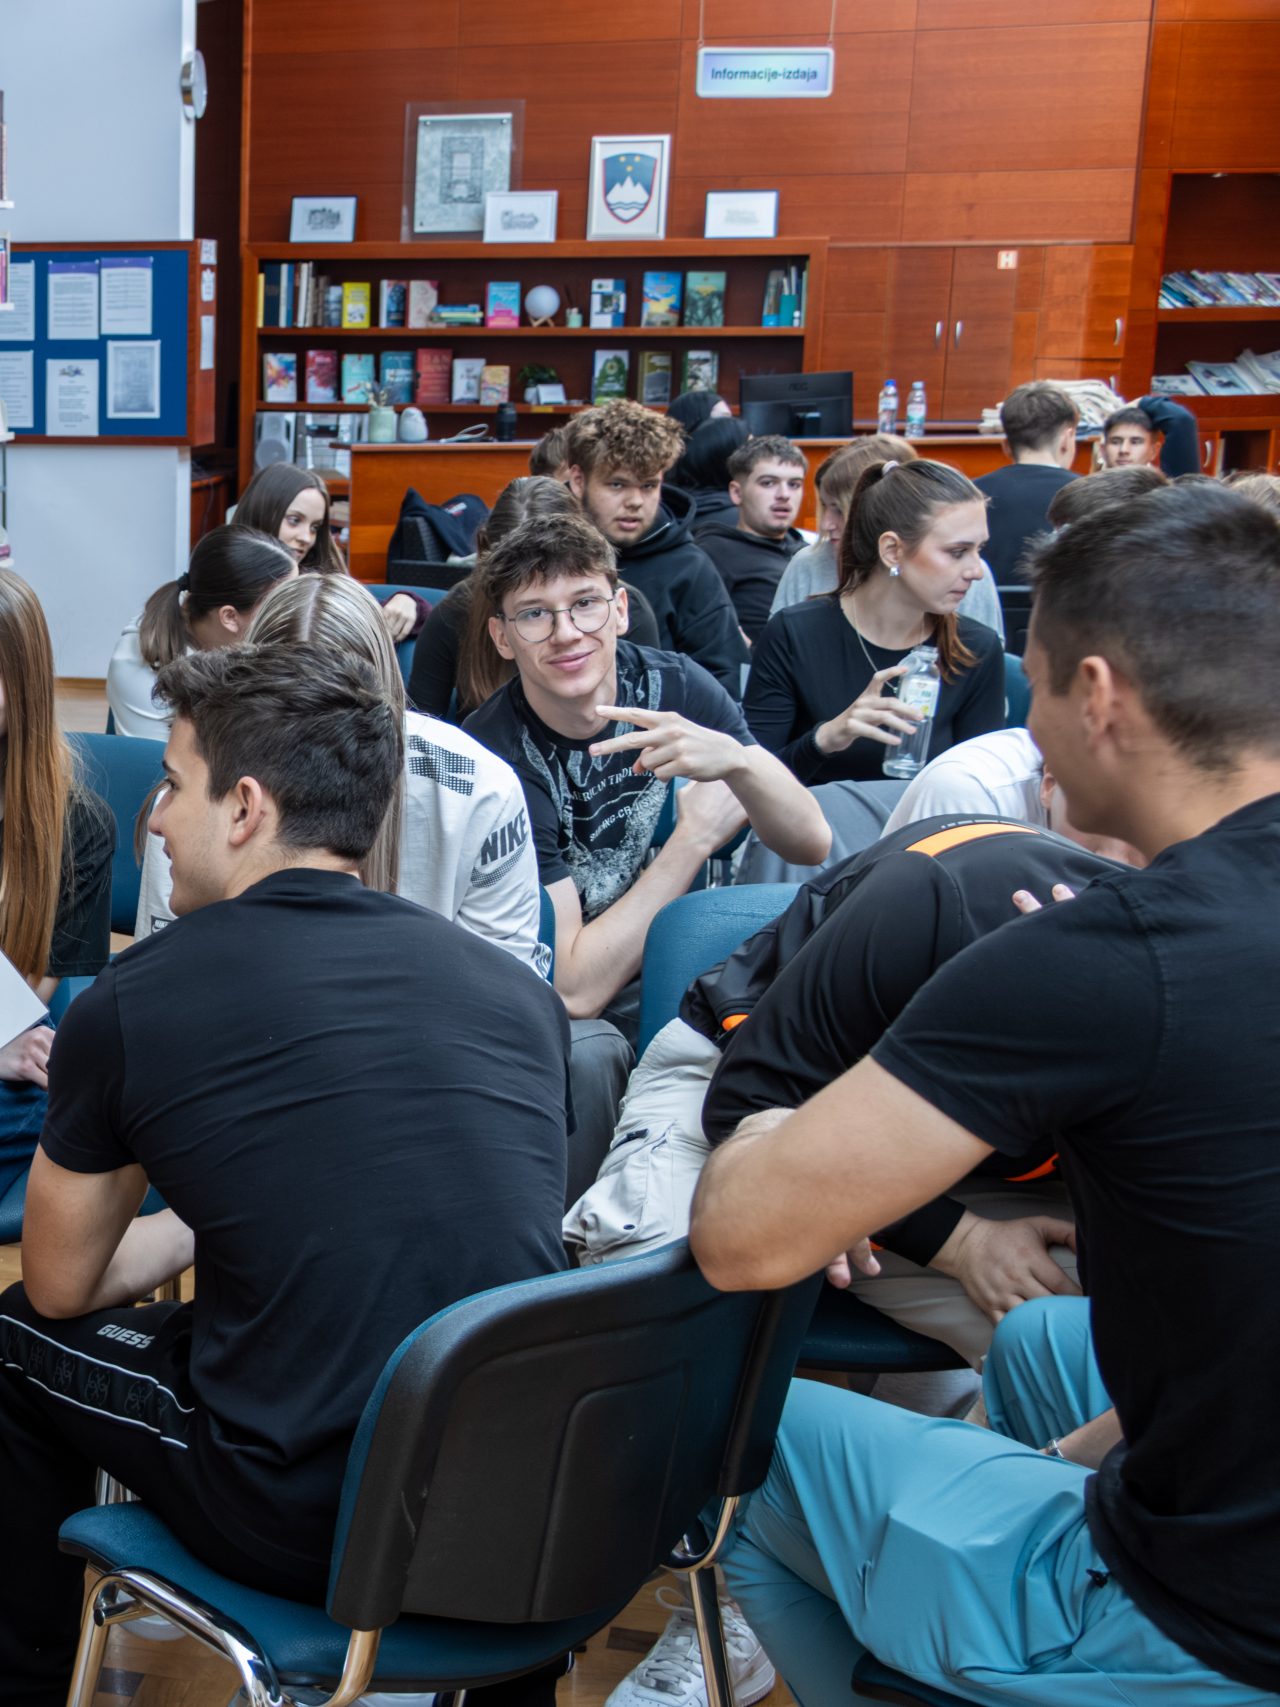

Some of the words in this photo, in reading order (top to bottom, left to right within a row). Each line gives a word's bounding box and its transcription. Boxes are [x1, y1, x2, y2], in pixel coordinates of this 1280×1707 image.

[711, 68, 818, 82] Informacije-izdaja
[481, 808, 529, 866] NIKE
[96, 1324, 156, 1349] GUESS
